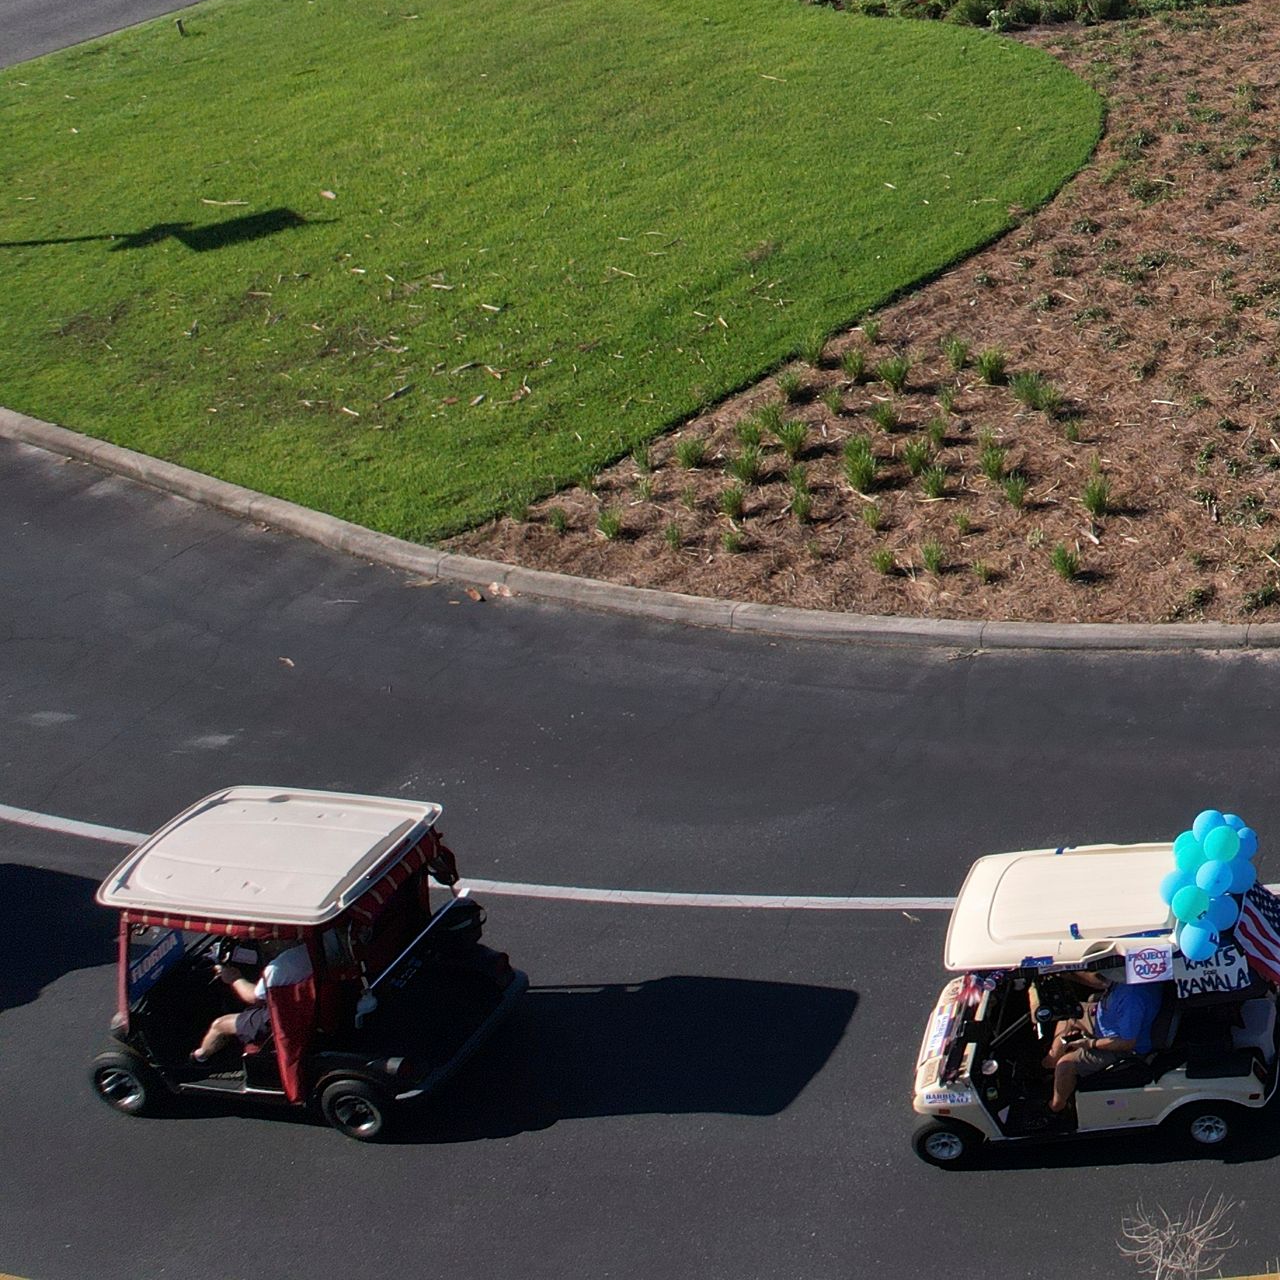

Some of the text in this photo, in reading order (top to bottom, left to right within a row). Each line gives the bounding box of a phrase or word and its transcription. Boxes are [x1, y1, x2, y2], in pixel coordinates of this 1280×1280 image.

[131, 933, 178, 984] FLORIDA
[1128, 950, 1168, 962] PROJECT
[1135, 962, 1167, 977] 2025
[1184, 944, 1235, 971] KARTS
[1177, 968, 1250, 998] KAMALA
